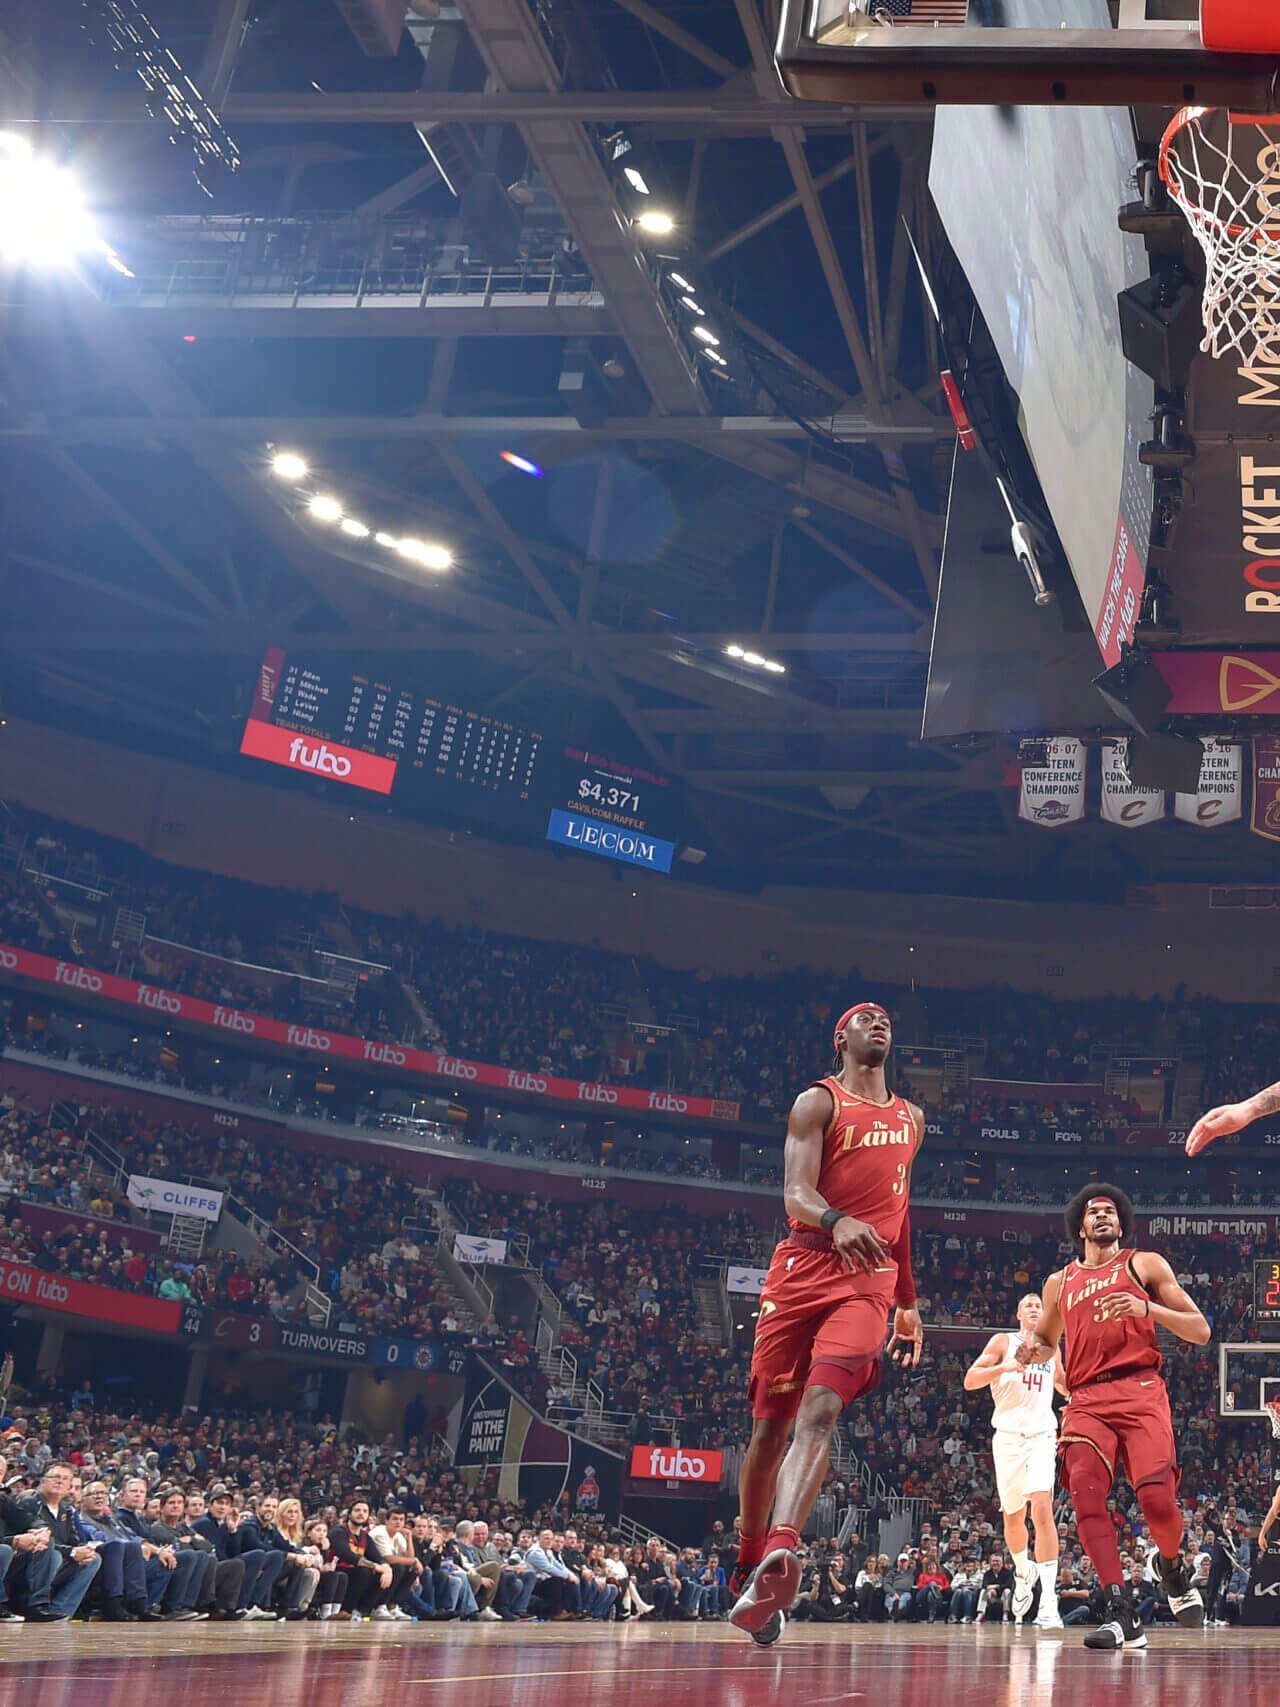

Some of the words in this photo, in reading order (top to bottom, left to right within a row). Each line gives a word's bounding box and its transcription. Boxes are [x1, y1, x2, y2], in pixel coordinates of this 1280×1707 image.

[1121, 587, 1135, 631] fubo
[1099, 594, 1116, 650] WATCH
[297, 689, 317, 701] Wade
[299, 680, 328, 695] Mitchell
[289, 738, 352, 776] fubo
[1201, 758, 1230, 769] STERN
[1023, 771, 1083, 783] CONFERENCE
[578, 778, 640, 812] $4,371
[1025, 784, 1080, 796] CHAMPIONS
[55, 961, 103, 992] fubo
[136, 985, 181, 1013] fubo
[213, 1006, 256, 1033] fubo
[287, 1025, 331, 1051] fubo
[363, 1040, 406, 1065] fubo
[436, 1056, 478, 1080] fubo
[506, 1070, 548, 1093] fubo
[577, 1082, 618, 1104] fubo
[648, 1092, 688, 1113] fubo
[873, 1120, 889, 1130] The
[842, 1124, 910, 1150] Land
[981, 1128, 1020, 1141] FOULS
[1054, 1132, 1082, 1143] FG%
[1168, 1131, 1186, 1145] 22
[893, 1163, 906, 1195] 3
[162, 1190, 218, 1212] CLIFFS
[7, 1270, 33, 1295] ON
[36, 1275, 69, 1303] fubo
[1067, 1271, 1119, 1312] Land
[183, 1318, 200, 1335] 44
[249, 1322, 261, 1343] 3
[281, 1329, 366, 1357] TURNOVERS
[386, 1344, 398, 1362] 0
[448, 1359, 464, 1374] 47
[1022, 1372, 1043, 1393] 44
[471, 1420, 484, 1436] IN
[484, 1419, 505, 1435] THE
[469, 1435, 503, 1453] PAINT
[649, 1448, 706, 1479] fubo
